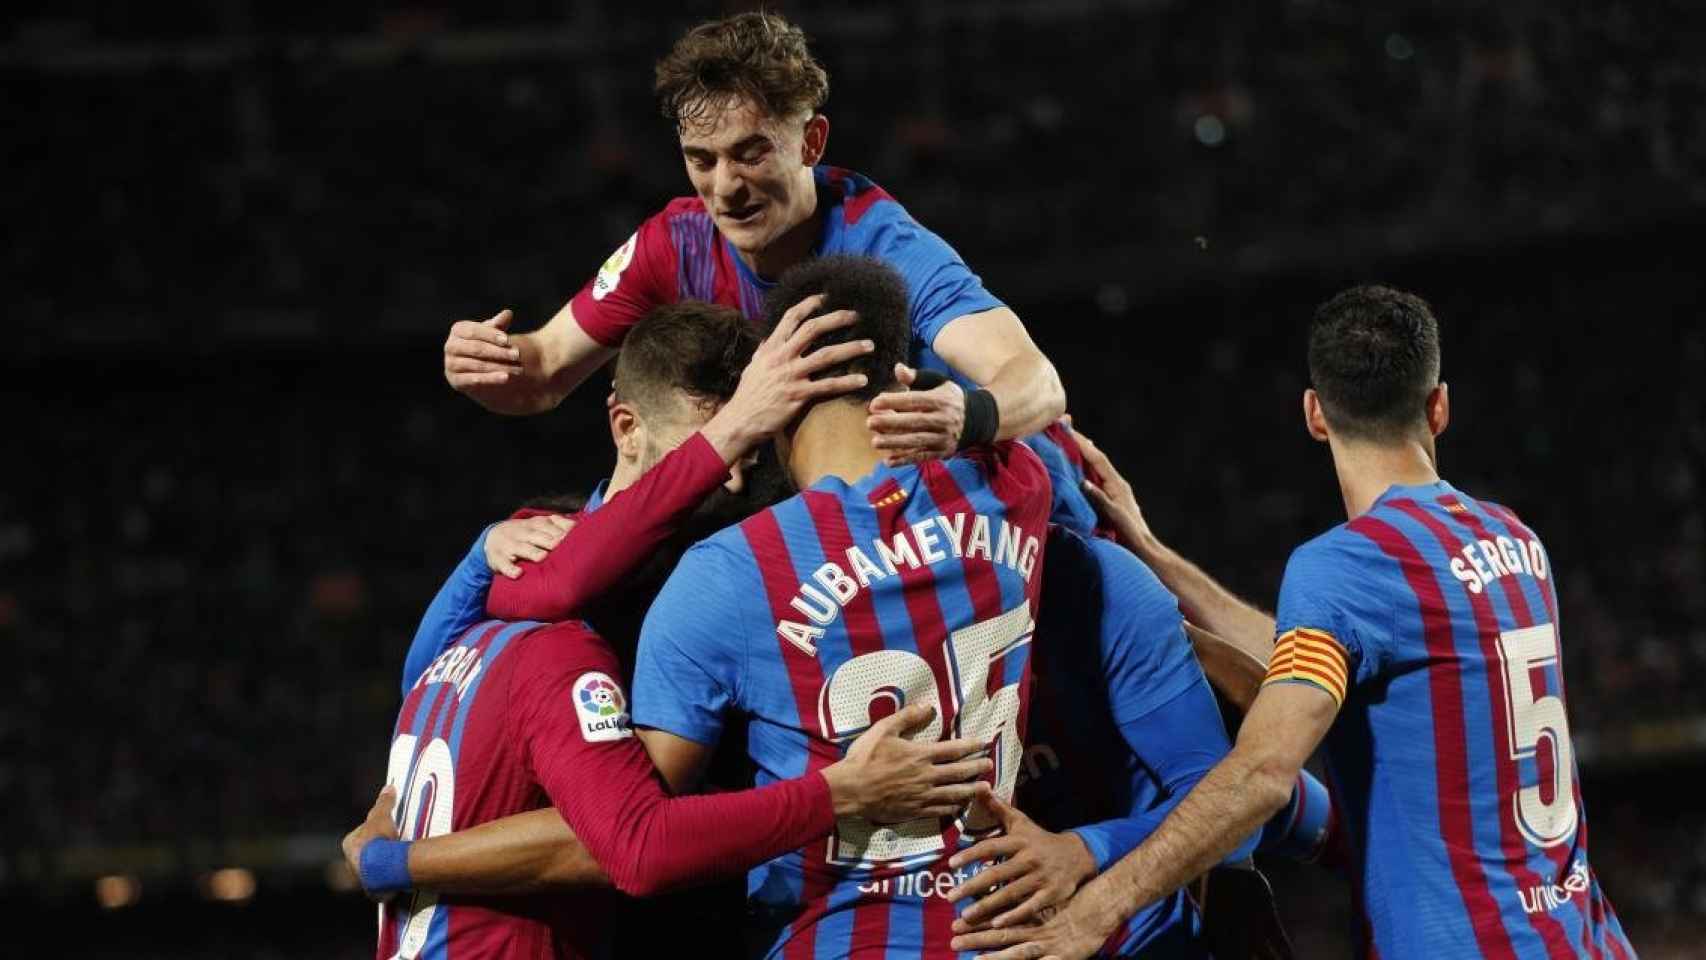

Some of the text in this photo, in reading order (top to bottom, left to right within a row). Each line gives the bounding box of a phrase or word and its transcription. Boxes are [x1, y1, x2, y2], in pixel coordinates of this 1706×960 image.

[777, 512, 1039, 657] AUBAMEYANG
[1450, 535, 1548, 594] SERGIO
[587, 717, 627, 733] LaLi
[818, 598, 1036, 868] 25
[1496, 623, 1579, 848] 5
[1516, 859, 1590, 913] unicef
